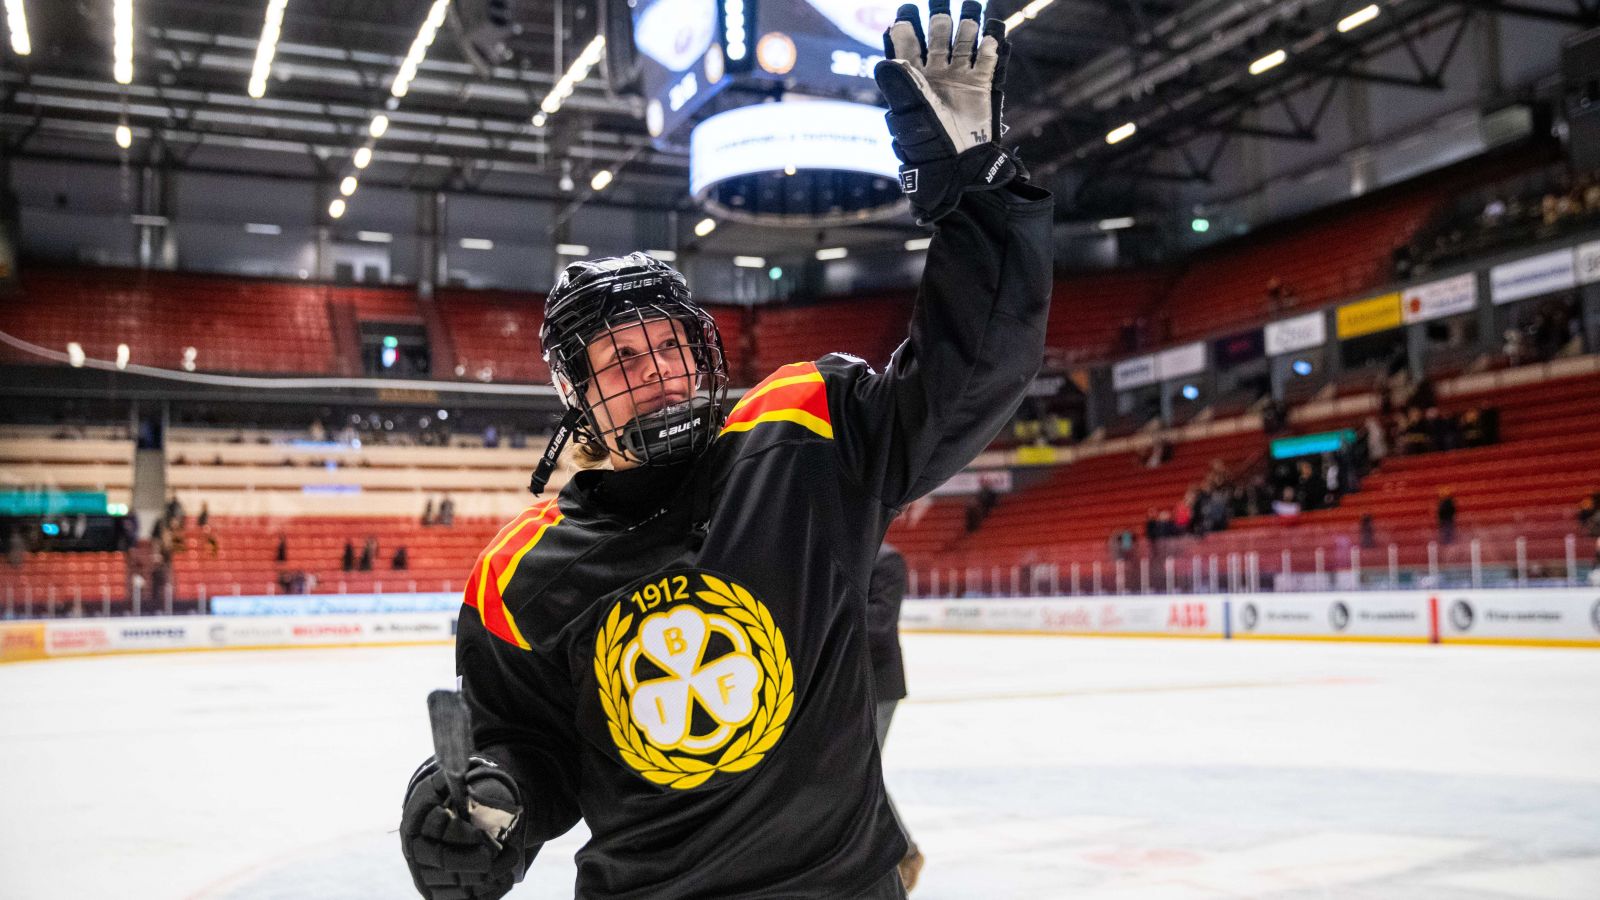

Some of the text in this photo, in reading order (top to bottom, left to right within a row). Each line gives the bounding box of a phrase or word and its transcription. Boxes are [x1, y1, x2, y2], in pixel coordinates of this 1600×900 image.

[612, 277, 663, 293] BAUER
[658, 417, 701, 439] BAUER
[631, 575, 690, 614] 1912
[1168, 603, 1208, 628] ABB
[662, 626, 688, 657] B
[715, 672, 736, 706] F
[654, 696, 667, 725] I
